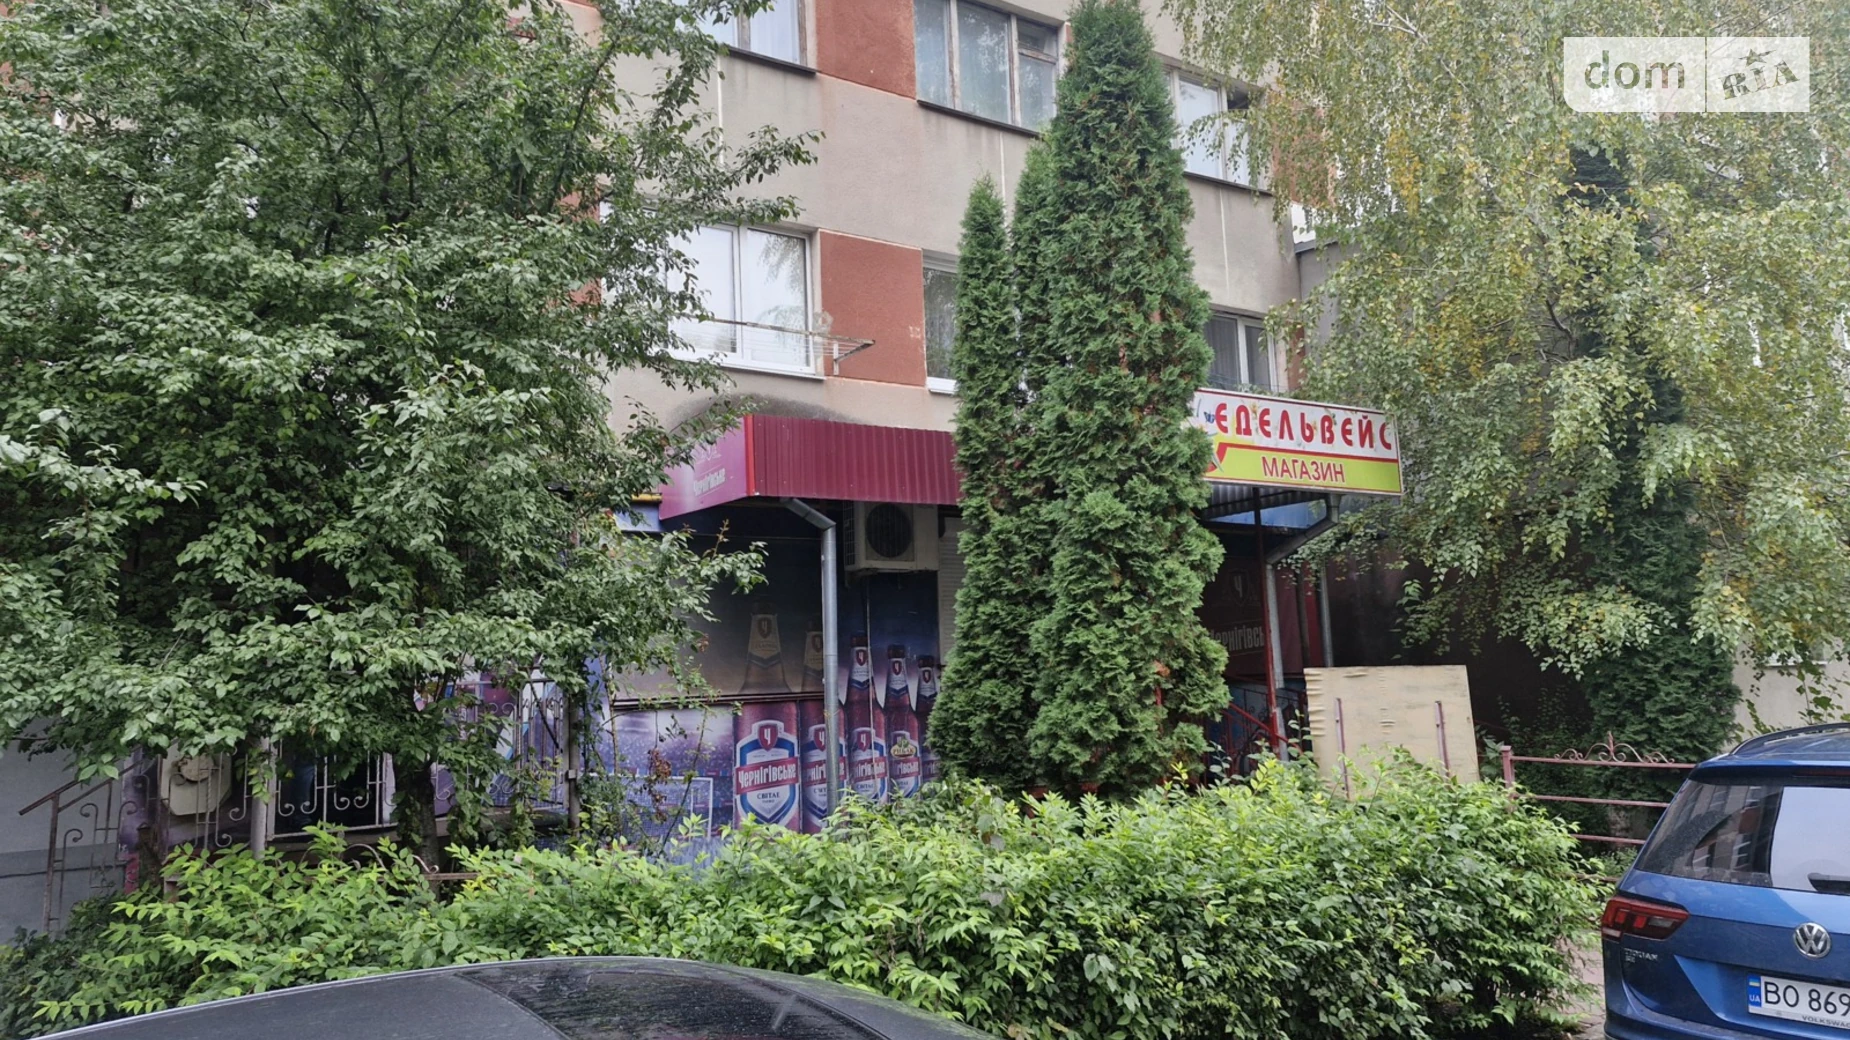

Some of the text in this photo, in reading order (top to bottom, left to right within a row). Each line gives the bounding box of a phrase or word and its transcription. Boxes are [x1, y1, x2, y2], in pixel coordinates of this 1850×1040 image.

[1214, 402, 1393, 451] ЕДЕЛЬВЕЙС
[1261, 456, 1346, 483] МАГАЗИН
[1748, 993, 1761, 1003] UA
[1763, 981, 1850, 1017] BO 869
